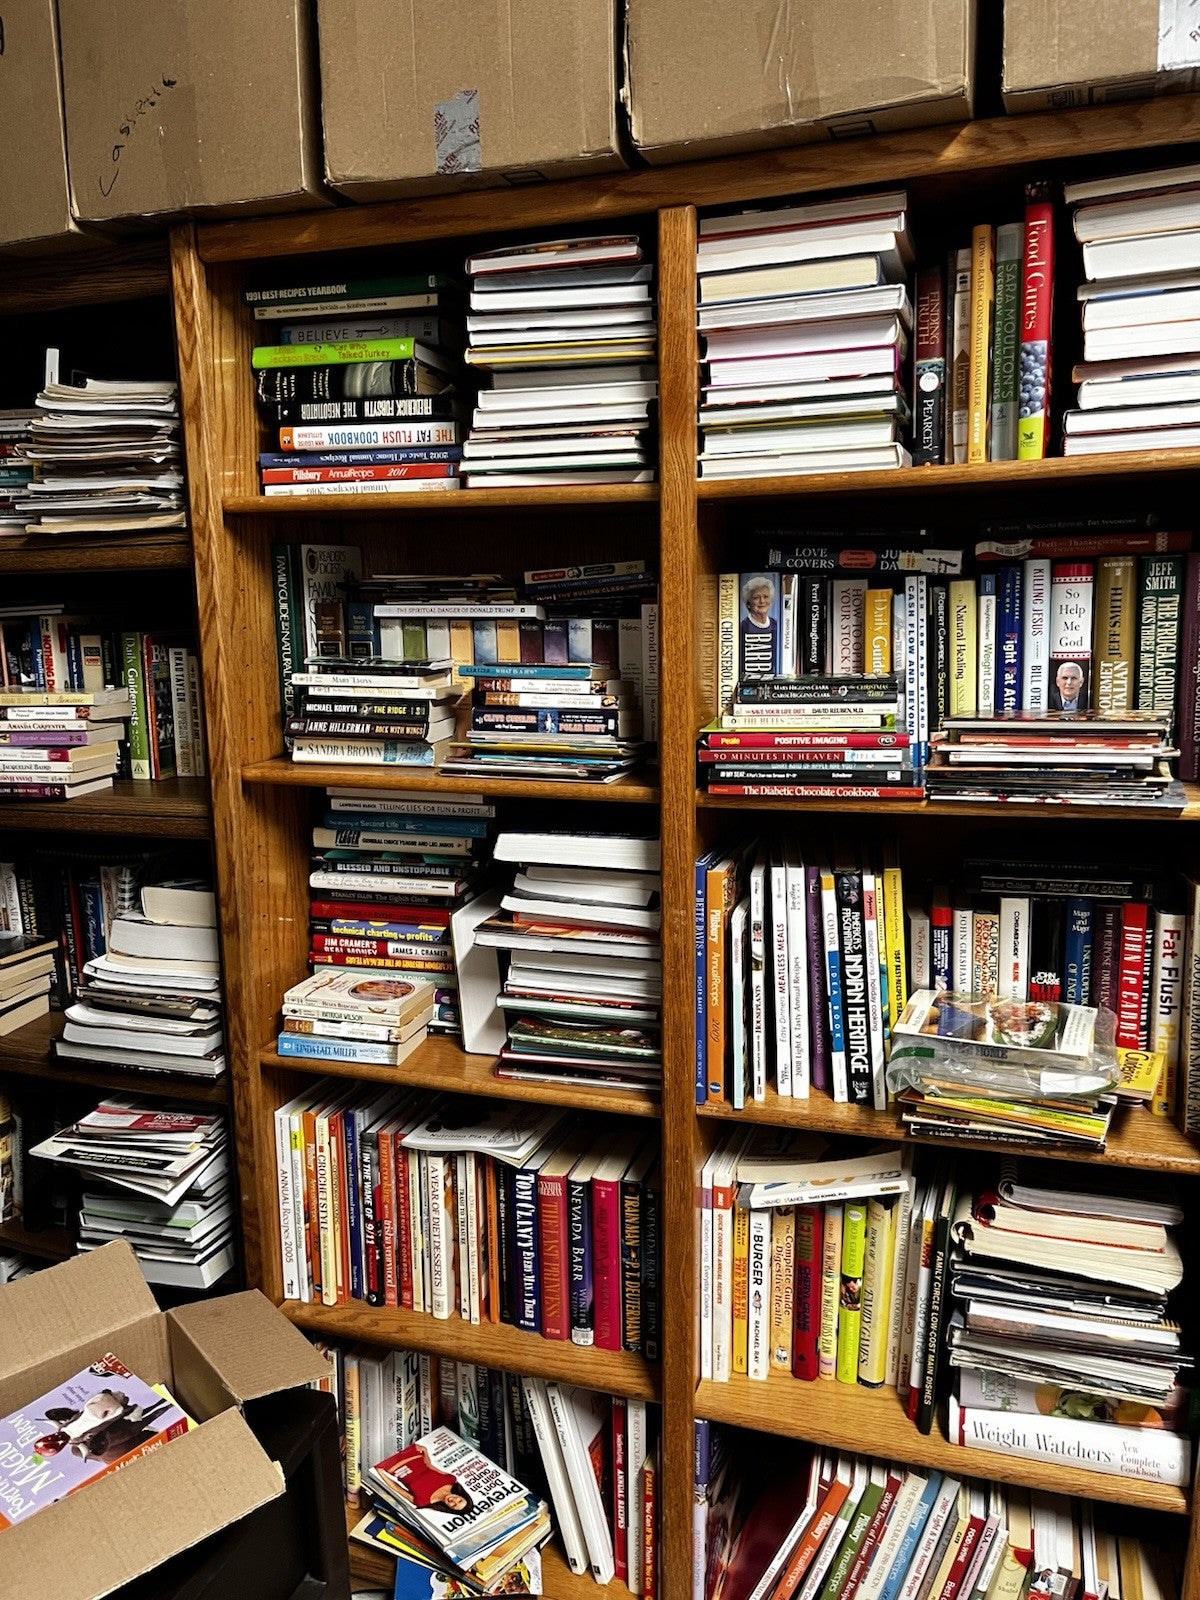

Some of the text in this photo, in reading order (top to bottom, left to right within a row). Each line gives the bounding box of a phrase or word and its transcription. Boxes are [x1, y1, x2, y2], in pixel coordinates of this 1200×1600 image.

[307, 284, 346, 296] YEARBOOK
[1005, 264, 1017, 306] SARA
[1025, 219, 1047, 330] Food Cures
[298, 328, 349, 342] BELIEVE
[918, 291, 940, 345] FINDING TRUTH
[974, 236, 986, 407] HOW RAISE CONSERVATIVE DAUGHTER
[364, 349, 390, 359] Turkey
[955, 362, 968, 400] Prayer
[328, 430, 453, 445] THE FAT FLUSH COOKBOOK
[387, 467, 407, 476] 2011
[786, 558, 835, 569] COVERS
[795, 548, 828, 557] LOVE
[1149, 563, 1173, 577] JEFF
[1065, 589, 1080, 599] So
[1146, 576, 1177, 590] SMITH
[852, 588, 862, 619] HOW
[870, 598, 887, 632] Daily
[1059, 604, 1086, 618] Help
[1108, 586, 1123, 657] JEFF SMITH
[841, 588, 850, 663] YOUR STOCK
[955, 605, 967, 680] Natural Healing
[1030, 568, 1044, 685] KILLING JESUS BILL
[1059, 637, 1084, 648] God
[1063, 621, 1081, 632] Me
[1140, 596, 1155, 652] COOKS THREE
[1155, 595, 1179, 667] THE FRUGAL
[43, 635, 54, 679] NOTHING
[721, 621, 733, 683] CHOLESTEROL
[1003, 633, 1018, 685] Fight Fat
[174, 651, 186, 703] BRAD TAYLOR
[982, 644, 992, 700] Weight Loss
[127, 668, 139, 726] Guideposts
[306, 703, 332, 712] MICHAEL
[334, 704, 357, 713] KORYTA
[374, 706, 385, 714] THE
[308, 722, 371, 733] ANNE HILLERMAN
[308, 744, 346, 756] SANDRA
[379, 803, 405, 812] TELLING
[406, 804, 422, 813] LIES
[423, 805, 435, 813] FOR
[743, 786, 880, 797] The Diabetic Chocolate Cookbook
[337, 863, 449, 875] BLESSED AND UNSTOPPABLE
[324, 938, 377, 949] JIM CRAMER'S
[332, 926, 433, 942] technical charting profits
[709, 909, 721, 944] Pillsbury
[826, 912, 837, 946] COLOR
[1123, 926, 1143, 962] JOHN
[392, 946, 448, 957] JAMES CRAMER
[776, 923, 786, 994] MEATLESS MEALS
[959, 914, 967, 985] JOHN GRISHAM
[988, 920, 998, 981] ACUPUNCTURE
[1101, 929, 1112, 967] PURPOSE
[793, 956, 801, 989] Recipes
[1159, 928, 1181, 1016] Fat Flush
[830, 965, 842, 1040] IDEA BOOK
[845, 954, 869, 1075] INDIAN HERITAGE
[869, 978, 879, 1032] holiday cooking
[711, 1019, 720, 1042] 2009
[281, 1169, 293, 1263] ANNUAL Recipes 2005
[363, 1164, 375, 1245] THE WAKE 9/11
[624, 1195, 639, 1247] TRAINMAN
[431, 1175, 442, 1287] YEAR DIET DESSERTS
[571, 1185, 584, 1281] NEVADA BARR
[753, 1234, 763, 1286] BURGER
[774, 1245, 783, 1294] Digestive
[784, 1235, 794, 1316] Complete Guide
[822, 1241, 837, 1354] THE DAY PLAN
[859, 1327, 870, 1366] GAMES
[923, 1251, 944, 1405] FAMILY CIRCLE LOW-COST MAIN DISHES
[972, 1420, 1112, 1463] Weight Watchers
[464, 1469, 490, 1486] ounce
[1120, 1454, 1161, 1469] Complete
[1120, 1464, 1162, 1479] Cookbook
[479, 1478, 504, 1496] Don't
[617, 1469, 625, 1529] ANNUAL RECIPES
[442, 1481, 523, 1533] Prevention
[810, 1512, 834, 1540] Pillsbury
[909, 1501, 930, 1530] Pillsbury
[848, 1513, 871, 1542] Pillsbury
